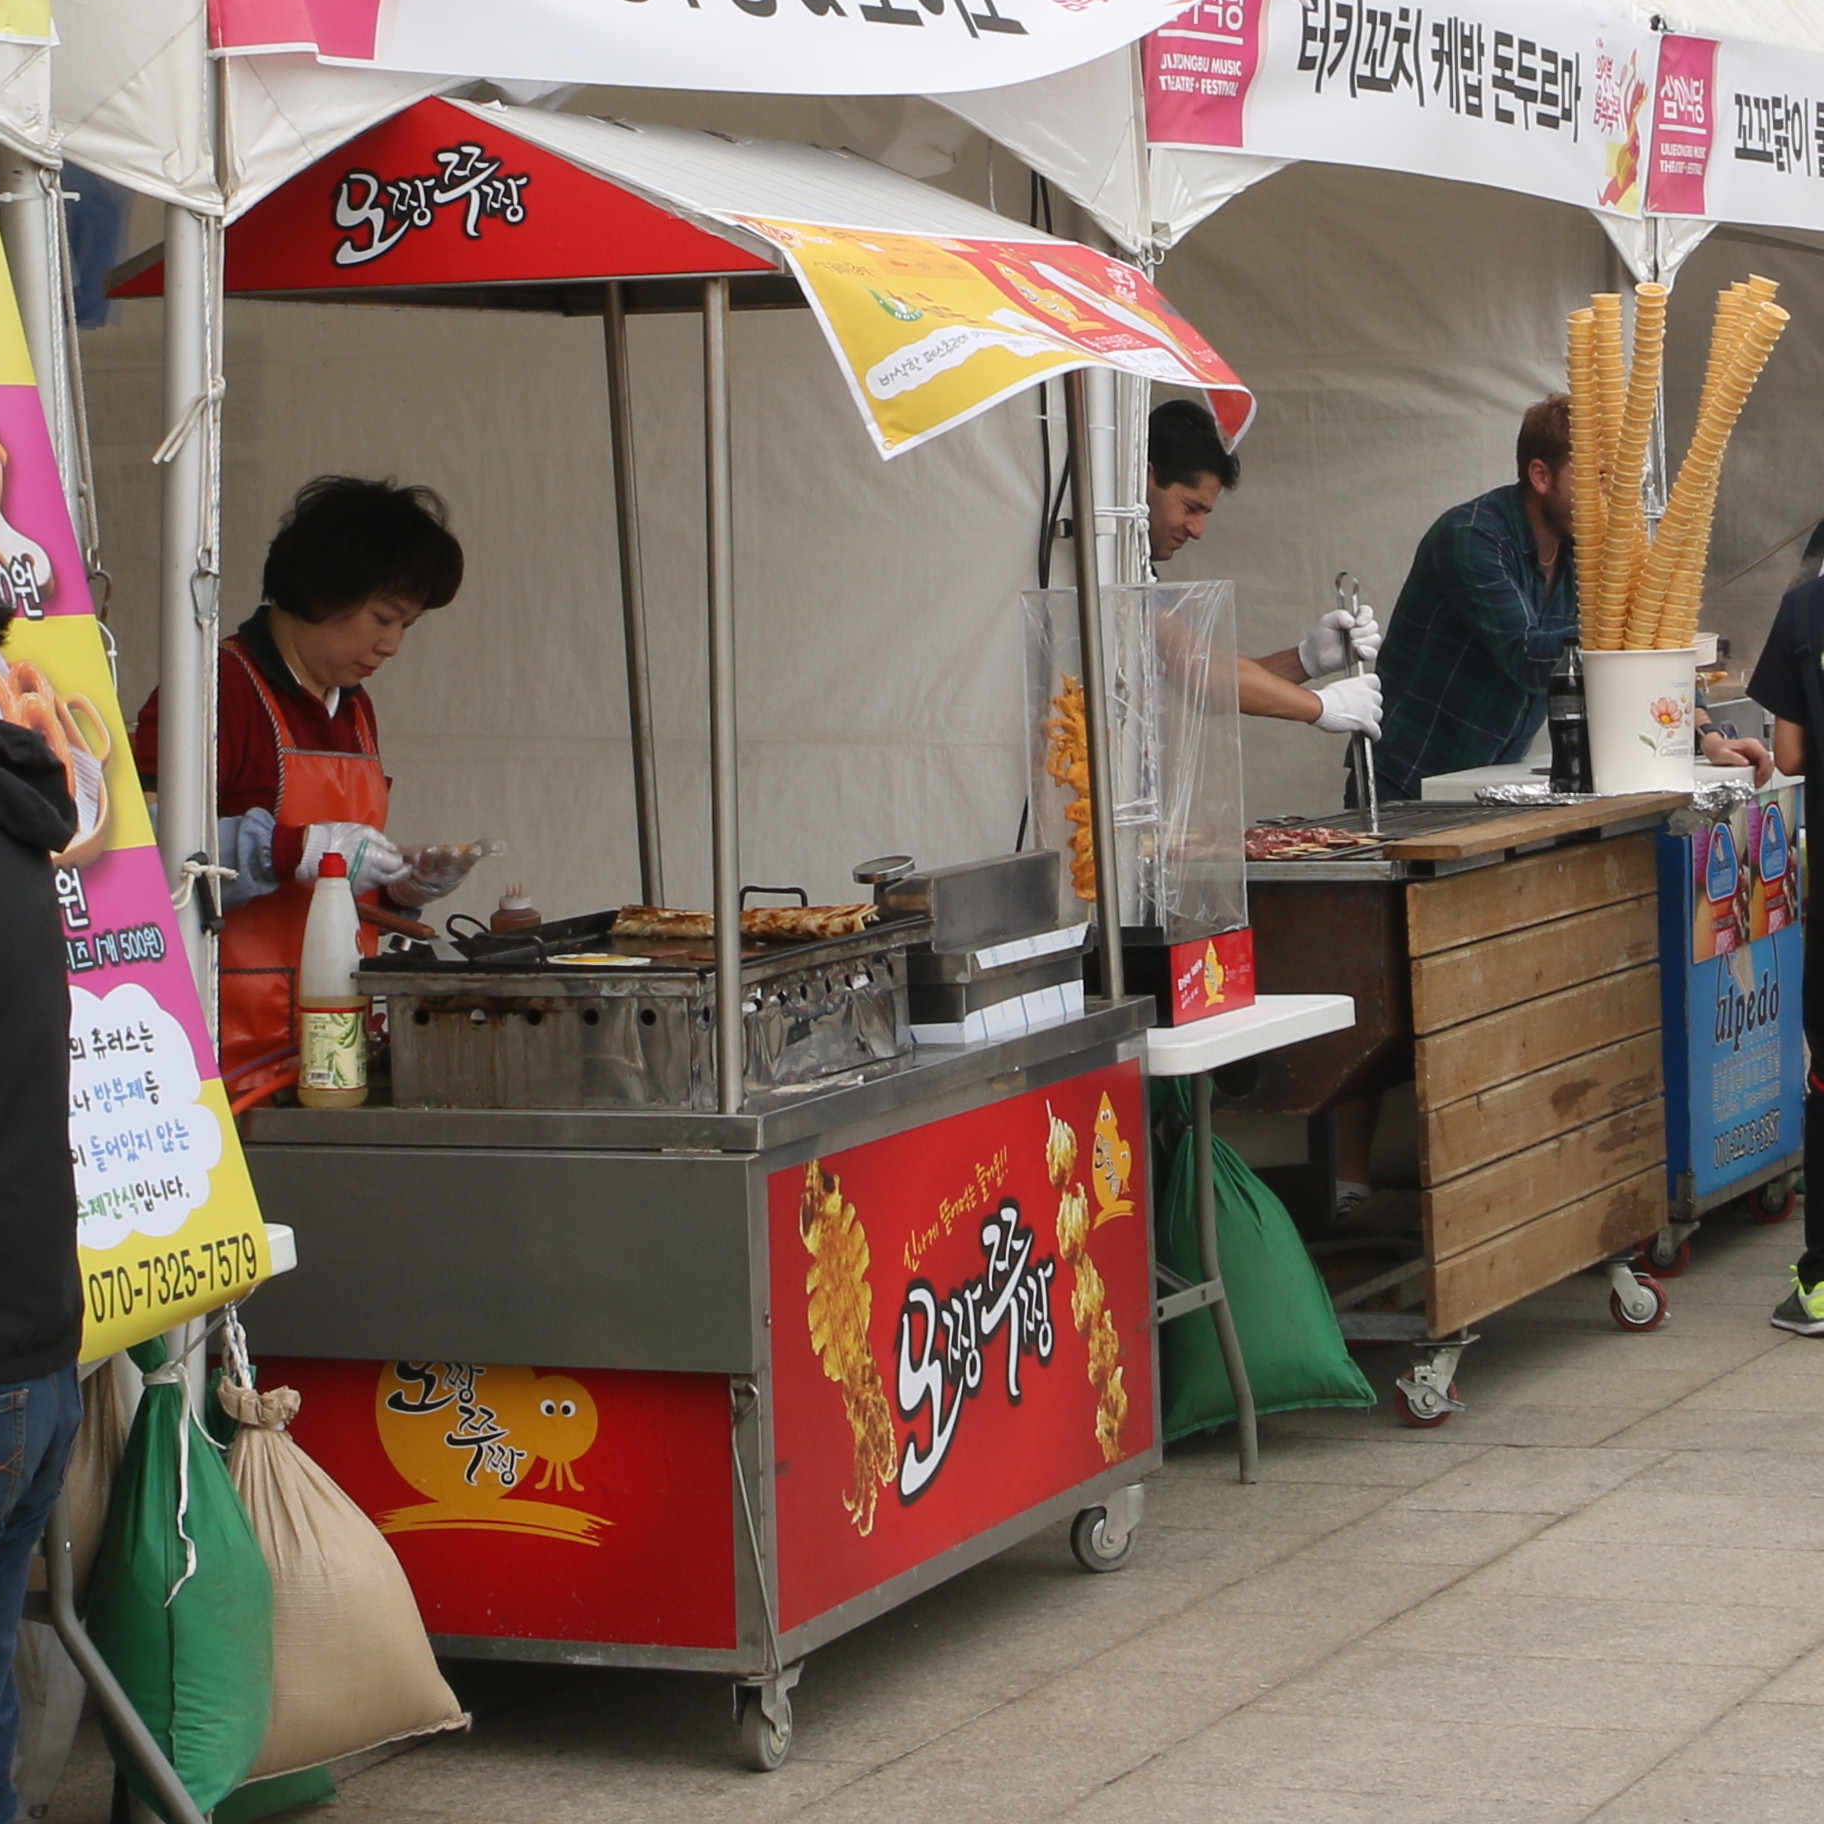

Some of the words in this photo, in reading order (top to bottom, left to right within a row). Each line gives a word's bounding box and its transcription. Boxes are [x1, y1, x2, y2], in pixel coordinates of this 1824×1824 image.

[1210, 55, 1243, 77] MUSIC
[1431, 15, 1486, 120] 케밥
[1492, 29, 1583, 144] 돈두르마
[1733, 92, 1812, 177] 꼬꼬닭이
[878, 353, 922, 388] 바삭한
[90, 1020, 155, 1062] 츄러스는
[89, 1127, 155, 1174] 들어있지
[155, 1117, 191, 1156] 않는
[87, 1231, 259, 1325] 070-7325-7579
